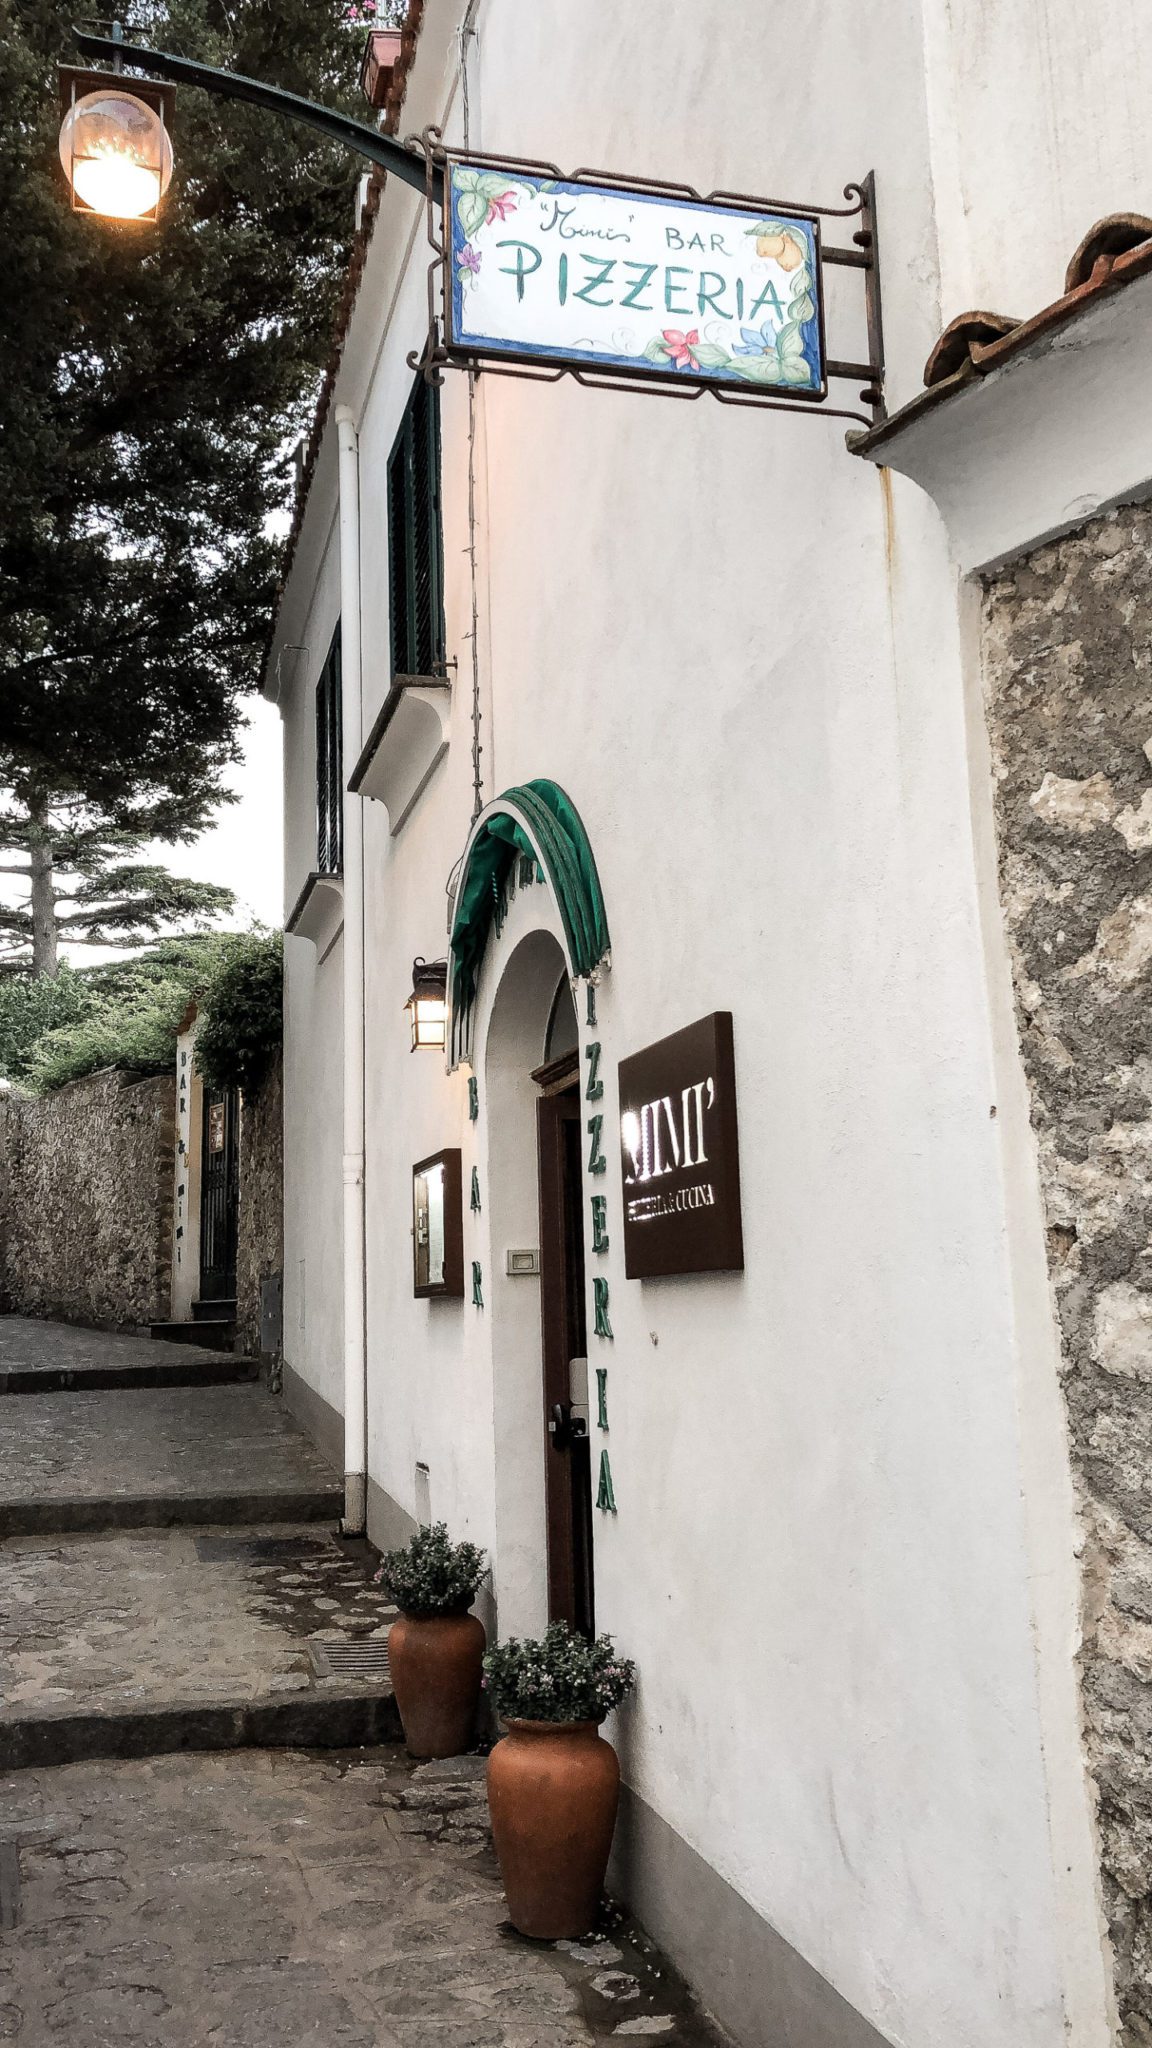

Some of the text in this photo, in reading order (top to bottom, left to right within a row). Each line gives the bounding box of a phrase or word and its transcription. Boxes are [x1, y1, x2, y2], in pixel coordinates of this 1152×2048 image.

[665, 227, 732, 256] BAR
[496, 240, 785, 325] PIZZERIA
[179, 1051, 188, 1113] BAR
[467, 1077, 484, 1307] BAR
[675, 1183, 716, 1212] CUCINA
[585, 984, 617, 1513] IZZERIA
